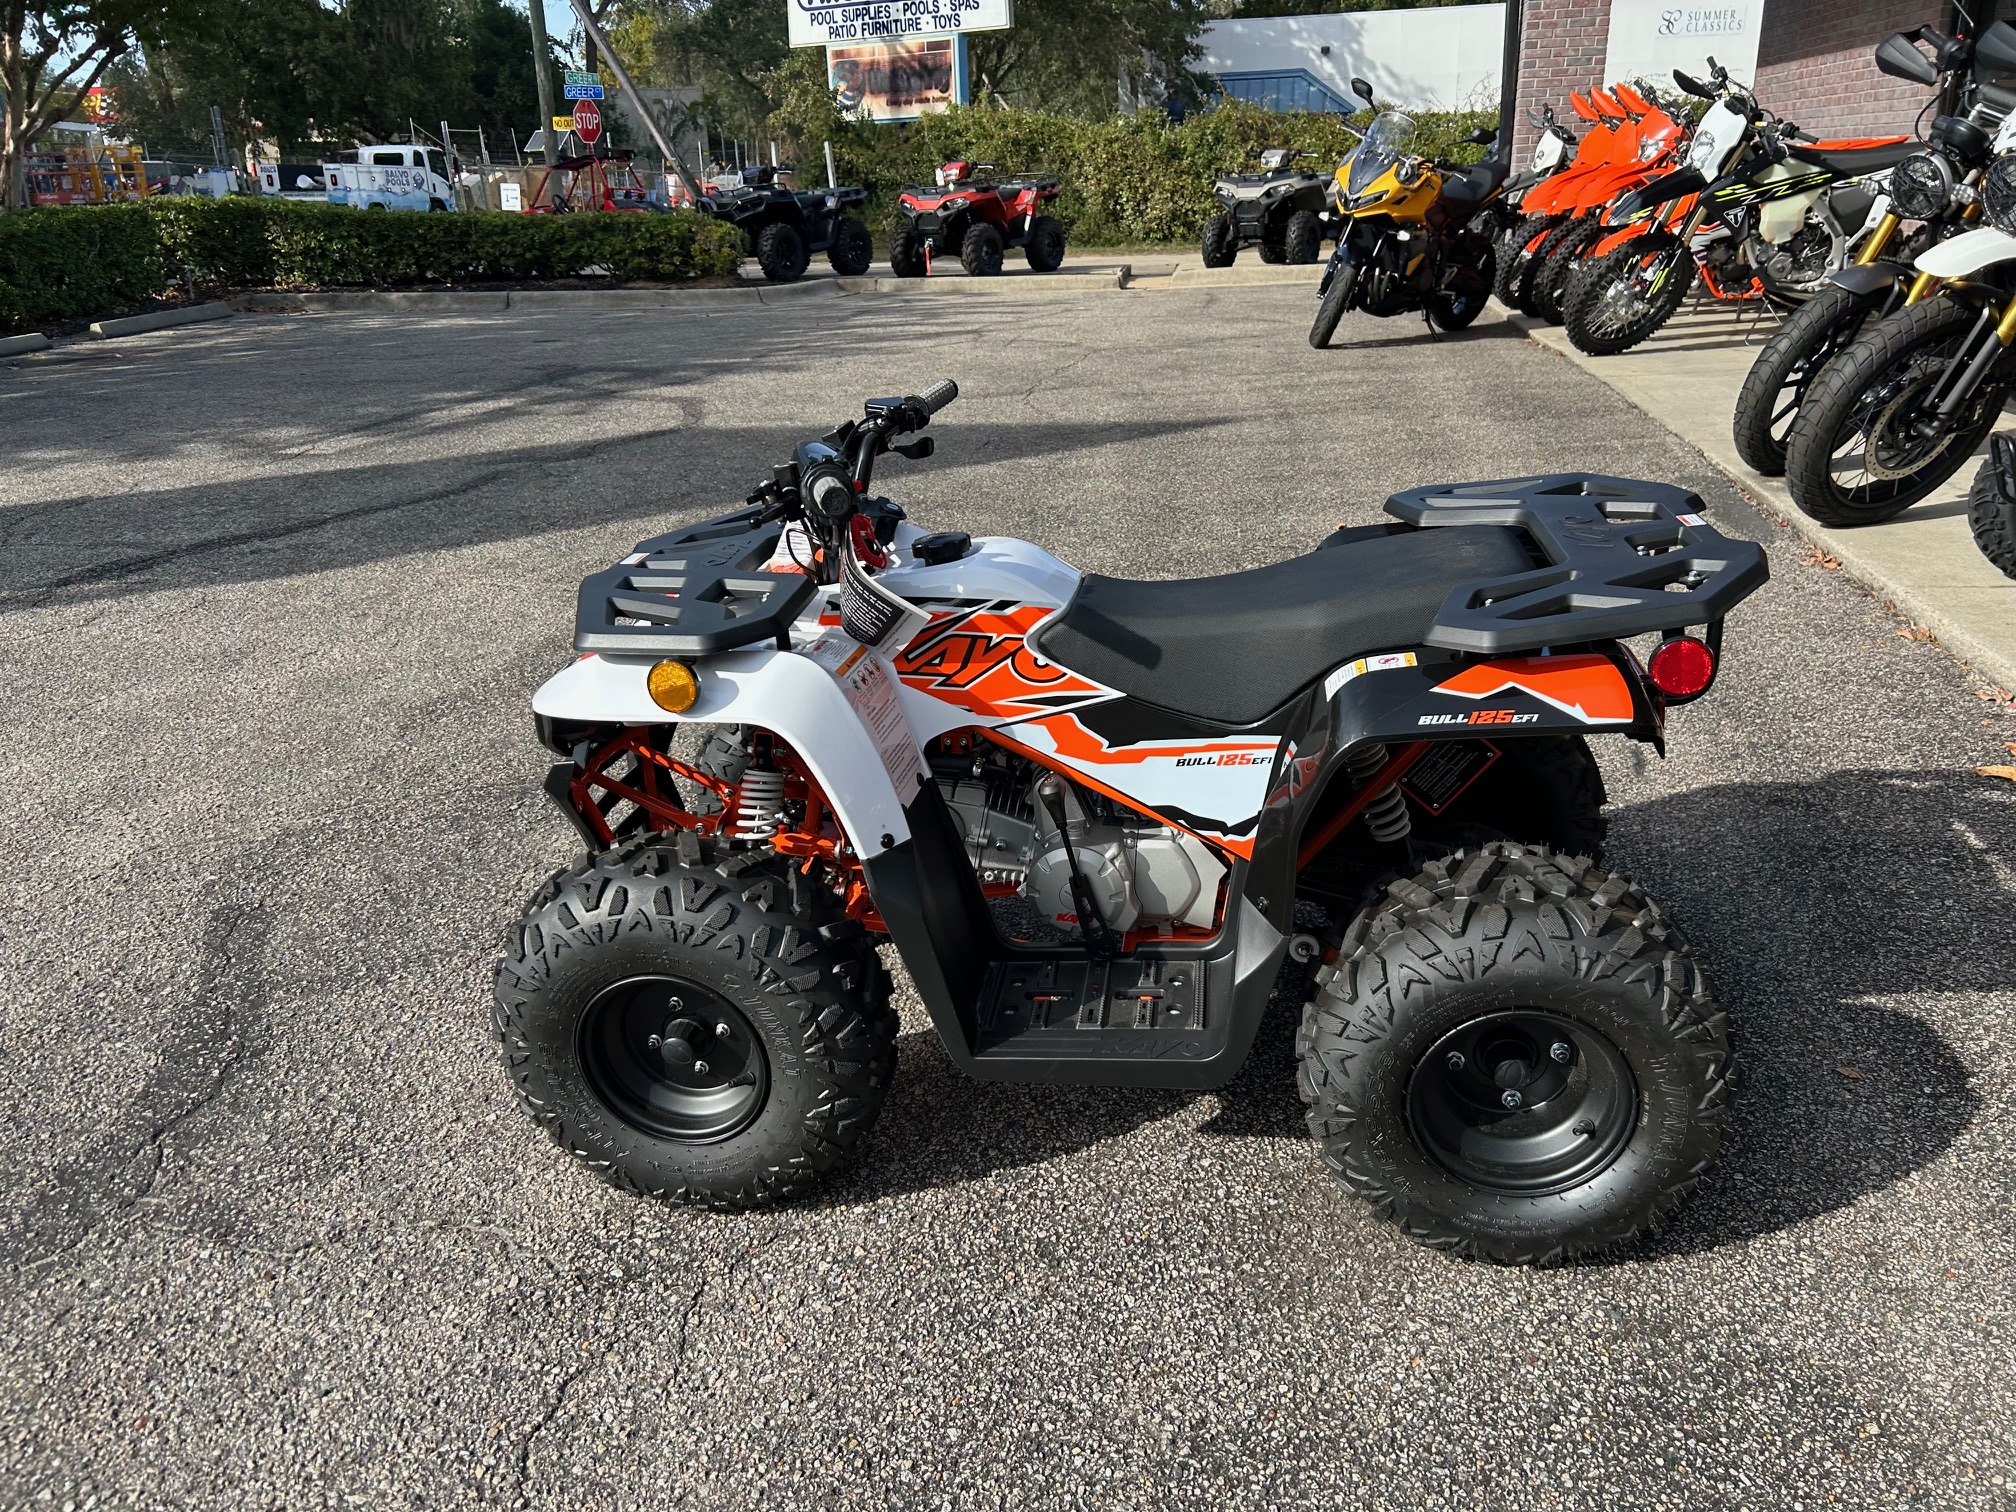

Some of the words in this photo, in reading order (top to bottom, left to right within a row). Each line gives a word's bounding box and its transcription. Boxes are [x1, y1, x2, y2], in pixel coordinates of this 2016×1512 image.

[810, 12, 838, 26] POOL
[841, 5, 892, 23] SUPPLIES
[902, 0, 940, 16] POOLS
[949, 0, 980, 12] SPAS
[1687, 9, 1736, 21] SUMMER
[828, 23, 857, 40] PATIO
[861, 18, 922, 37] FURNITURE
[933, 13, 961, 29] TOYS
[1686, 19, 1743, 32] CLASSICS
[567, 72, 593, 84] GREER
[566, 87, 595, 97] GREER
[554, 119, 563, 128] NO
[576, 112, 599, 129] STOP
[385, 169, 409, 178] SALVO
[386, 178, 410, 186] POOLS
